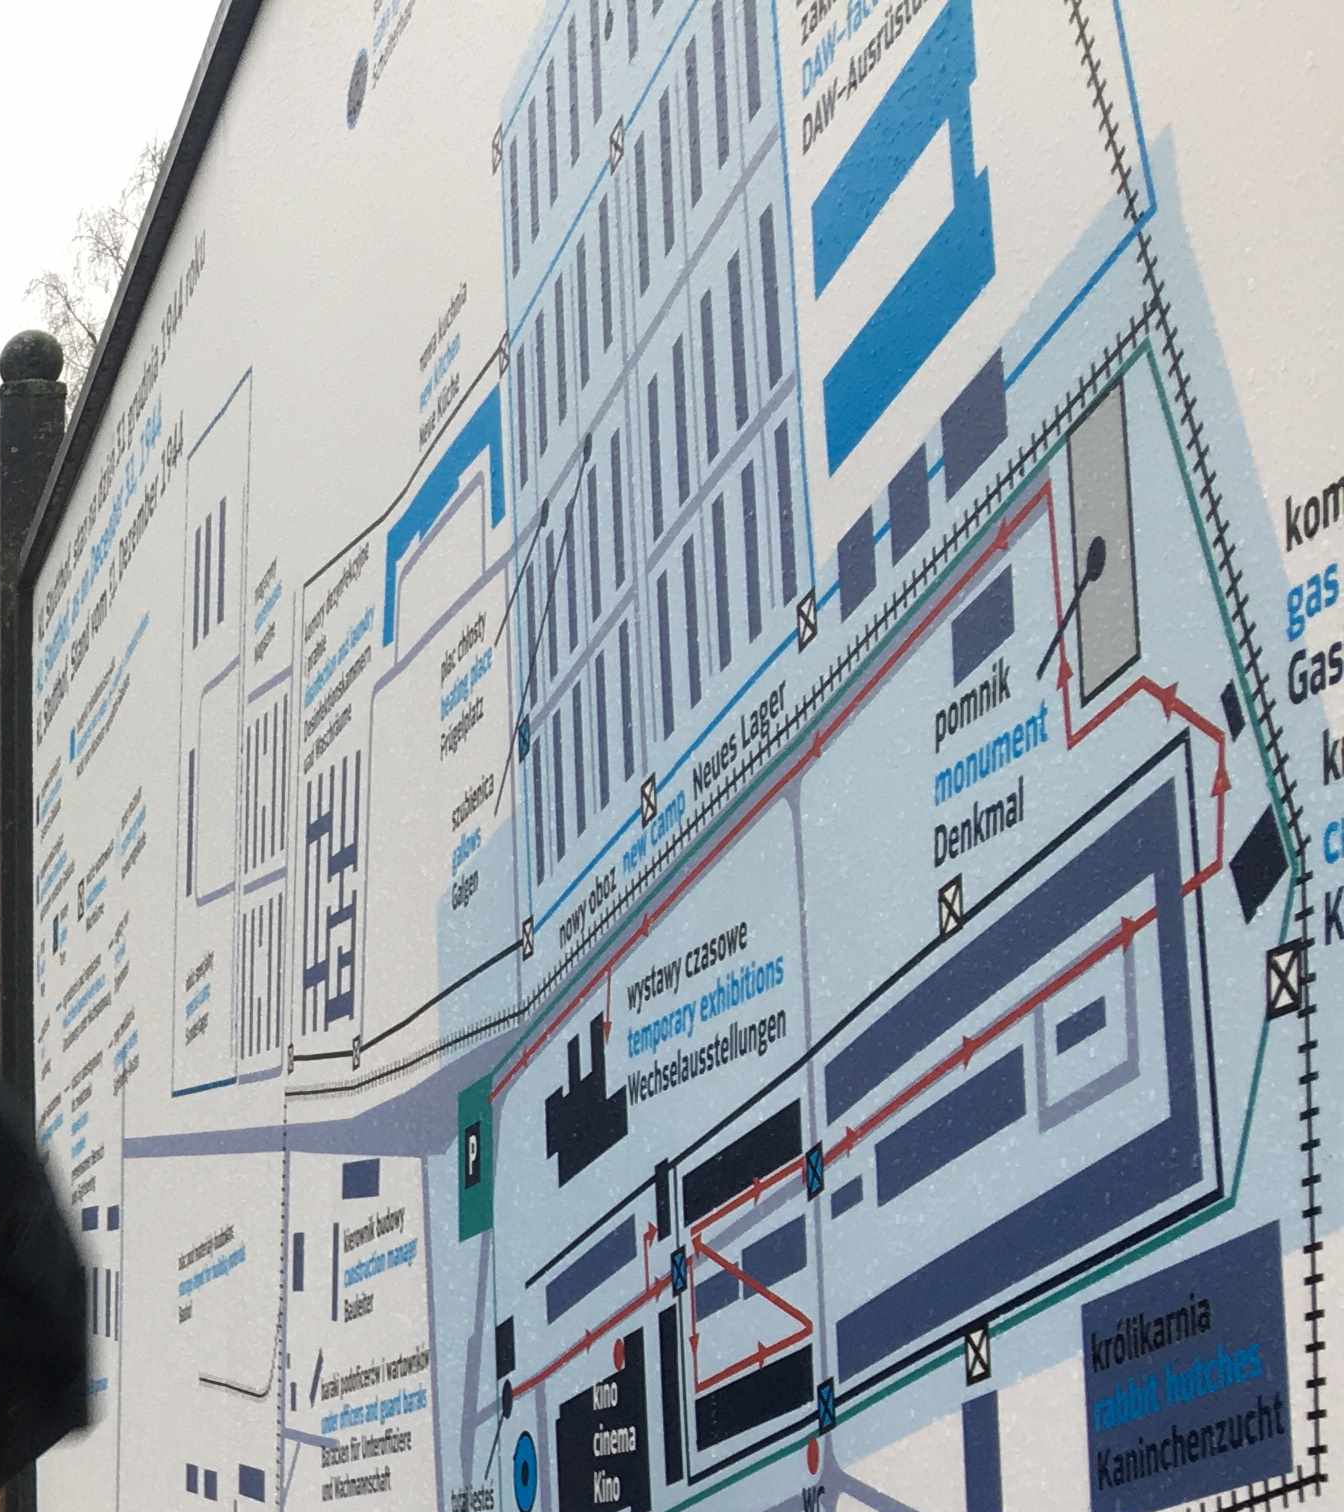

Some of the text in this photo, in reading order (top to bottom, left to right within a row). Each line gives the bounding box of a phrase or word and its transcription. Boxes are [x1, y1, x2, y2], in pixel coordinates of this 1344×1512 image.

[1285, 563, 1340, 643] gas
[935, 656, 1011, 755] pomnik
[935, 699, 1048, 807] monument
[559, 898, 588, 949] nowy
[622, 840, 647, 876] new
[651, 789, 686, 848] camp
[692, 733, 738, 801] Neues
[741, 680, 787, 746] Lager
[934, 775, 1024, 868] Denkmal
[627, 921, 748, 1014] wystawy czasowe
[627, 955, 784, 1058] temporary exhibitions
[627, 1008, 787, 1106] Wechselausstellungen
[469, 1135, 477, 1176] P
[1091, 1292, 1212, 1374] królikarnia
[593, 1382, 618, 1411] kino
[1093, 1343, 1264, 1433] rabbit hutches
[593, 1423, 636, 1457] cinema
[593, 1469, 621, 1504] Kino
[1097, 1391, 1286, 1492] Kaninchenzucht
